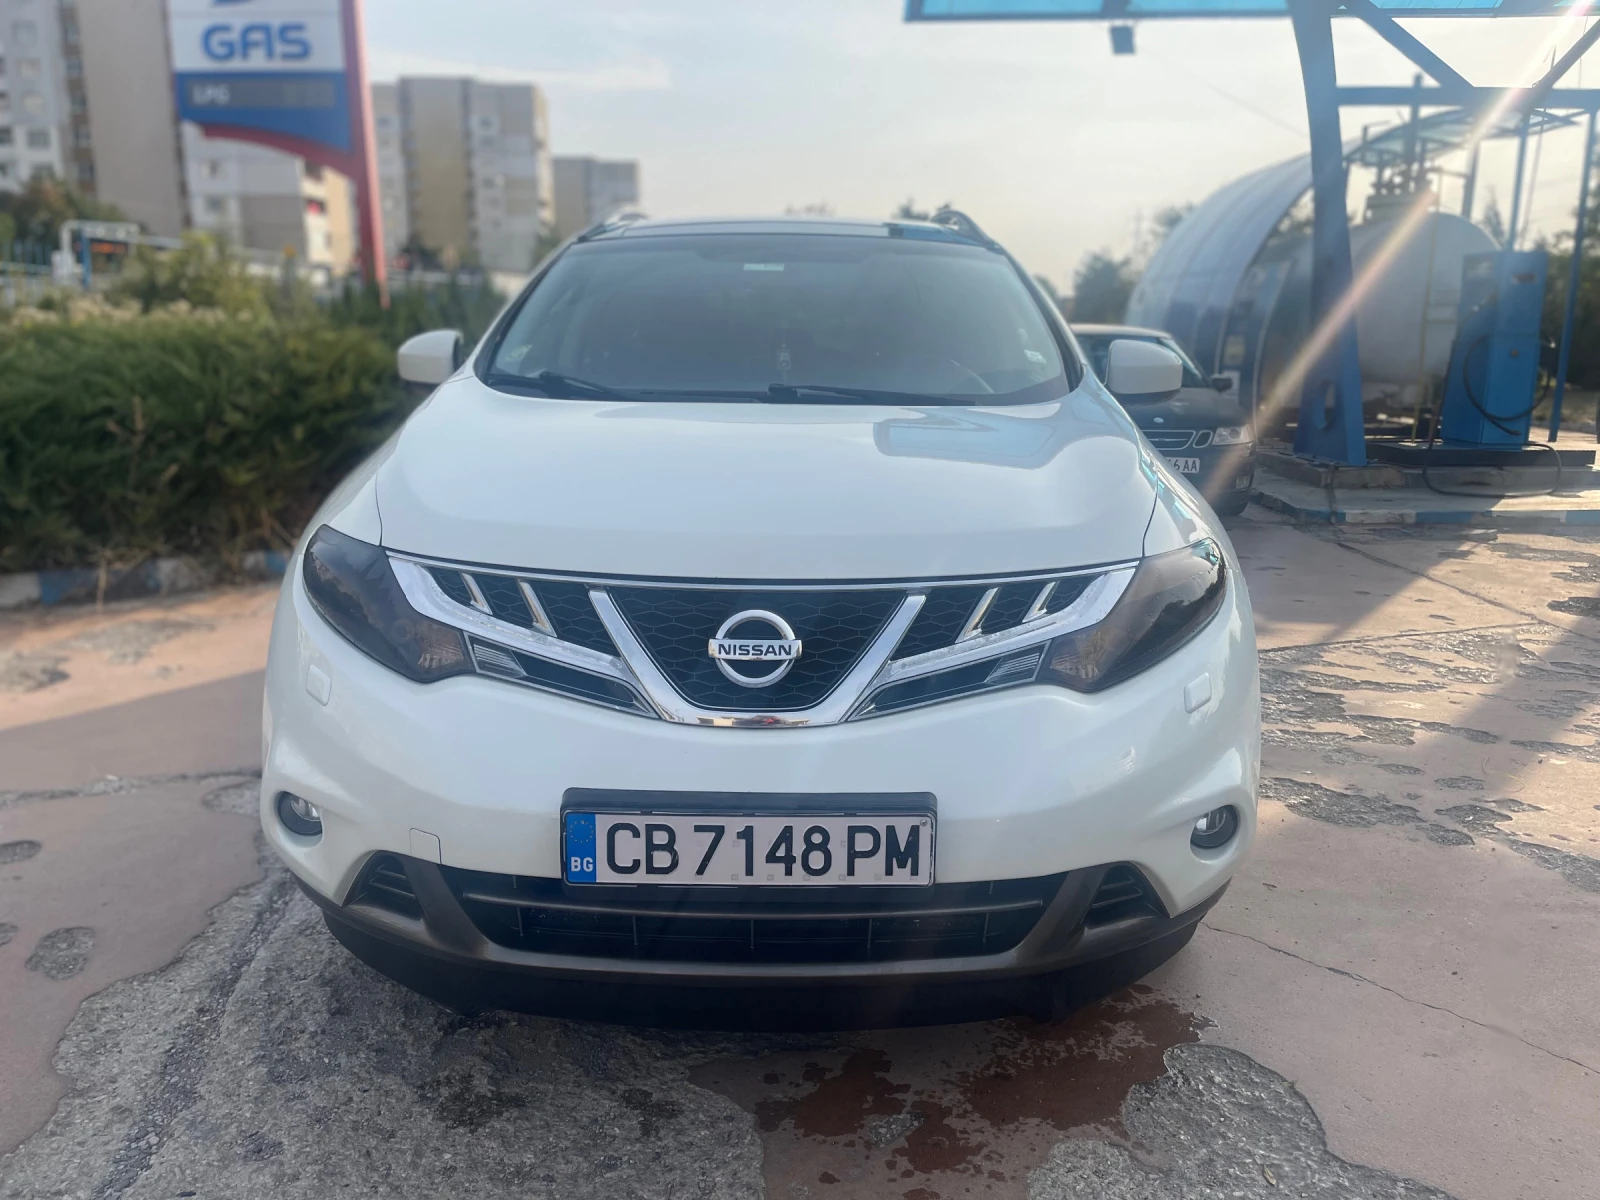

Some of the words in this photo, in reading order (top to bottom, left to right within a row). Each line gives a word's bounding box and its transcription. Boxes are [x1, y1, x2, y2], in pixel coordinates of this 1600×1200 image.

[202, 24, 311, 60] GAS
[1183, 460, 1197, 471] AA
[718, 644, 792, 656] NISSAN
[606, 823, 679, 875] CB
[693, 825, 833, 877] 7148
[847, 825, 920, 876] PM
[570, 856, 594, 872] BG
